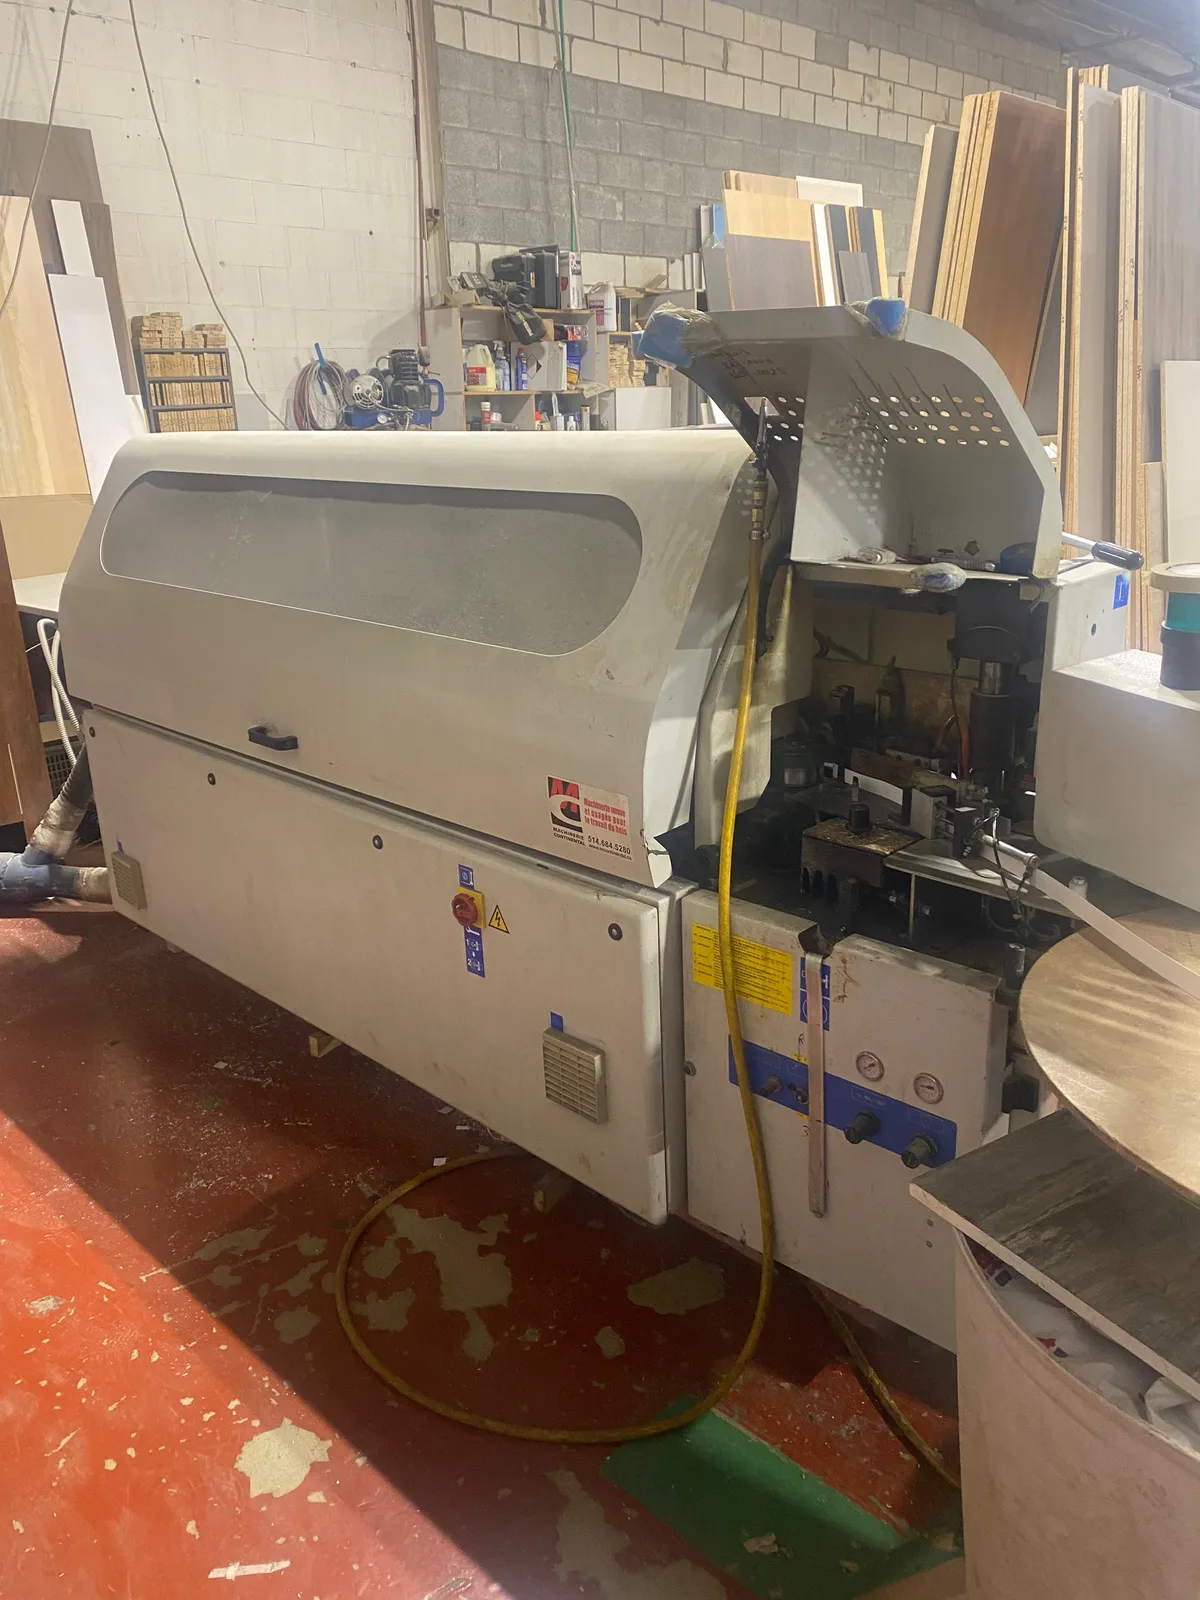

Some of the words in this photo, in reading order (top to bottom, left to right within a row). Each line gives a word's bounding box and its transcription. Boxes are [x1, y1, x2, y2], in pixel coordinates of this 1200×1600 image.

[553, 827, 584, 840] MACHINERIE
[554, 833, 586, 846] CONTINENTAL
[588, 835, 631, 854] 514.684.5280
